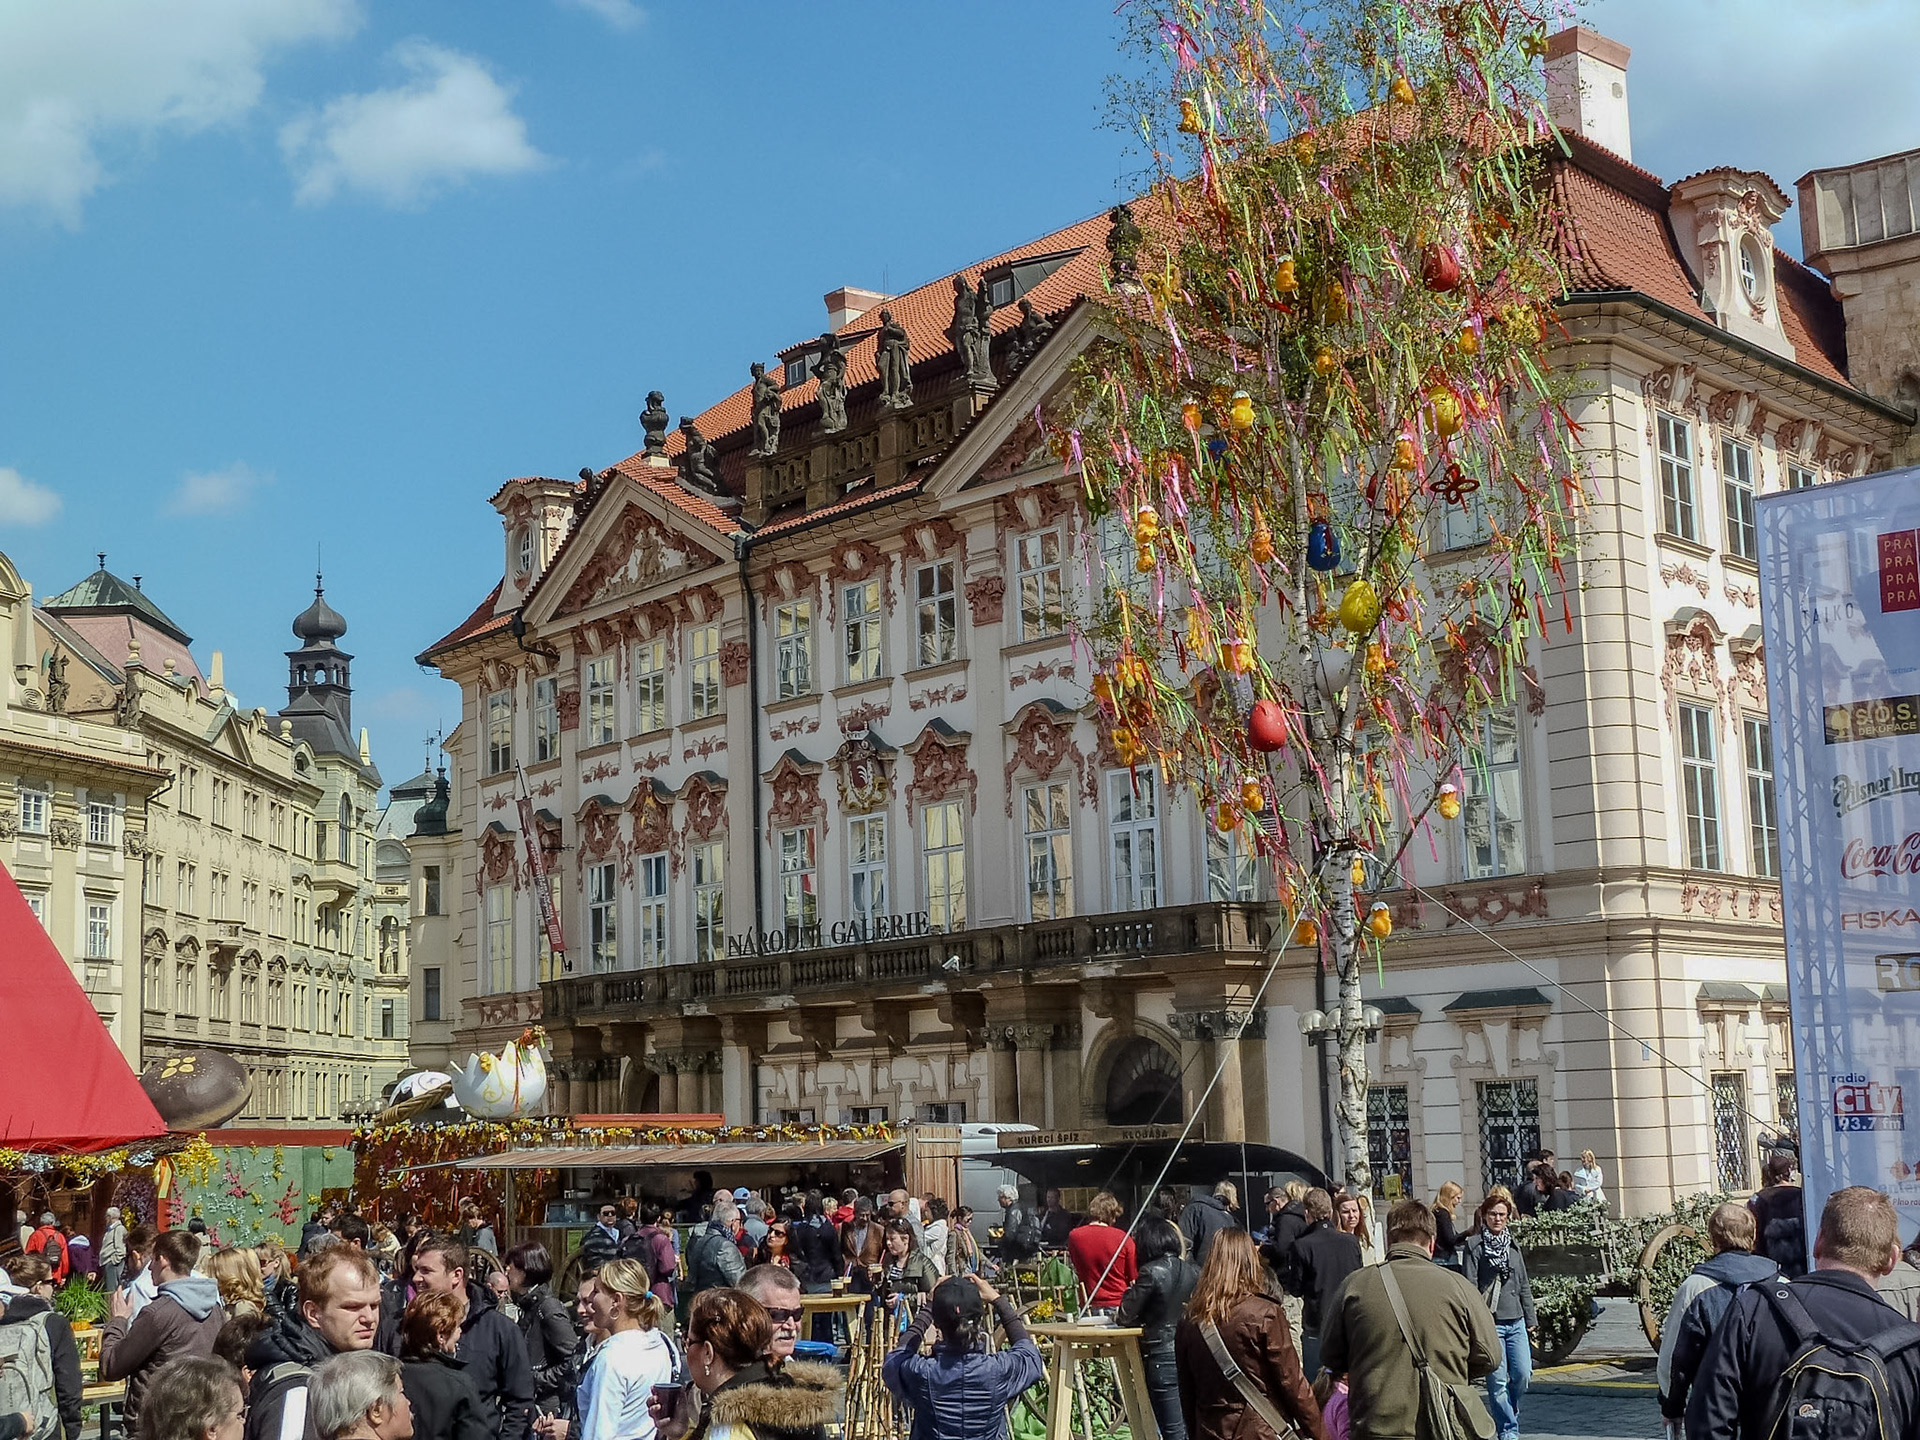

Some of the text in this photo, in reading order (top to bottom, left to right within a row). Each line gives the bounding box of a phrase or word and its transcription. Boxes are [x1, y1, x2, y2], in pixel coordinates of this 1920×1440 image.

[1884, 538, 1912, 551] PRA
[1885, 555, 1914, 568] PRA
[1886, 572, 1915, 585] PRA
[1887, 590, 1917, 603] PRA
[1801, 602, 1853, 626] TAIKO
[1858, 721, 1917, 736] DEKORACE
[1832, 774, 1891, 818] Pilsner
[726, 911, 929, 957] NÁRODNÍ GALERIE
[1831, 1072, 1866, 1083] radio
[1839, 1116, 1877, 1130] 93.7
